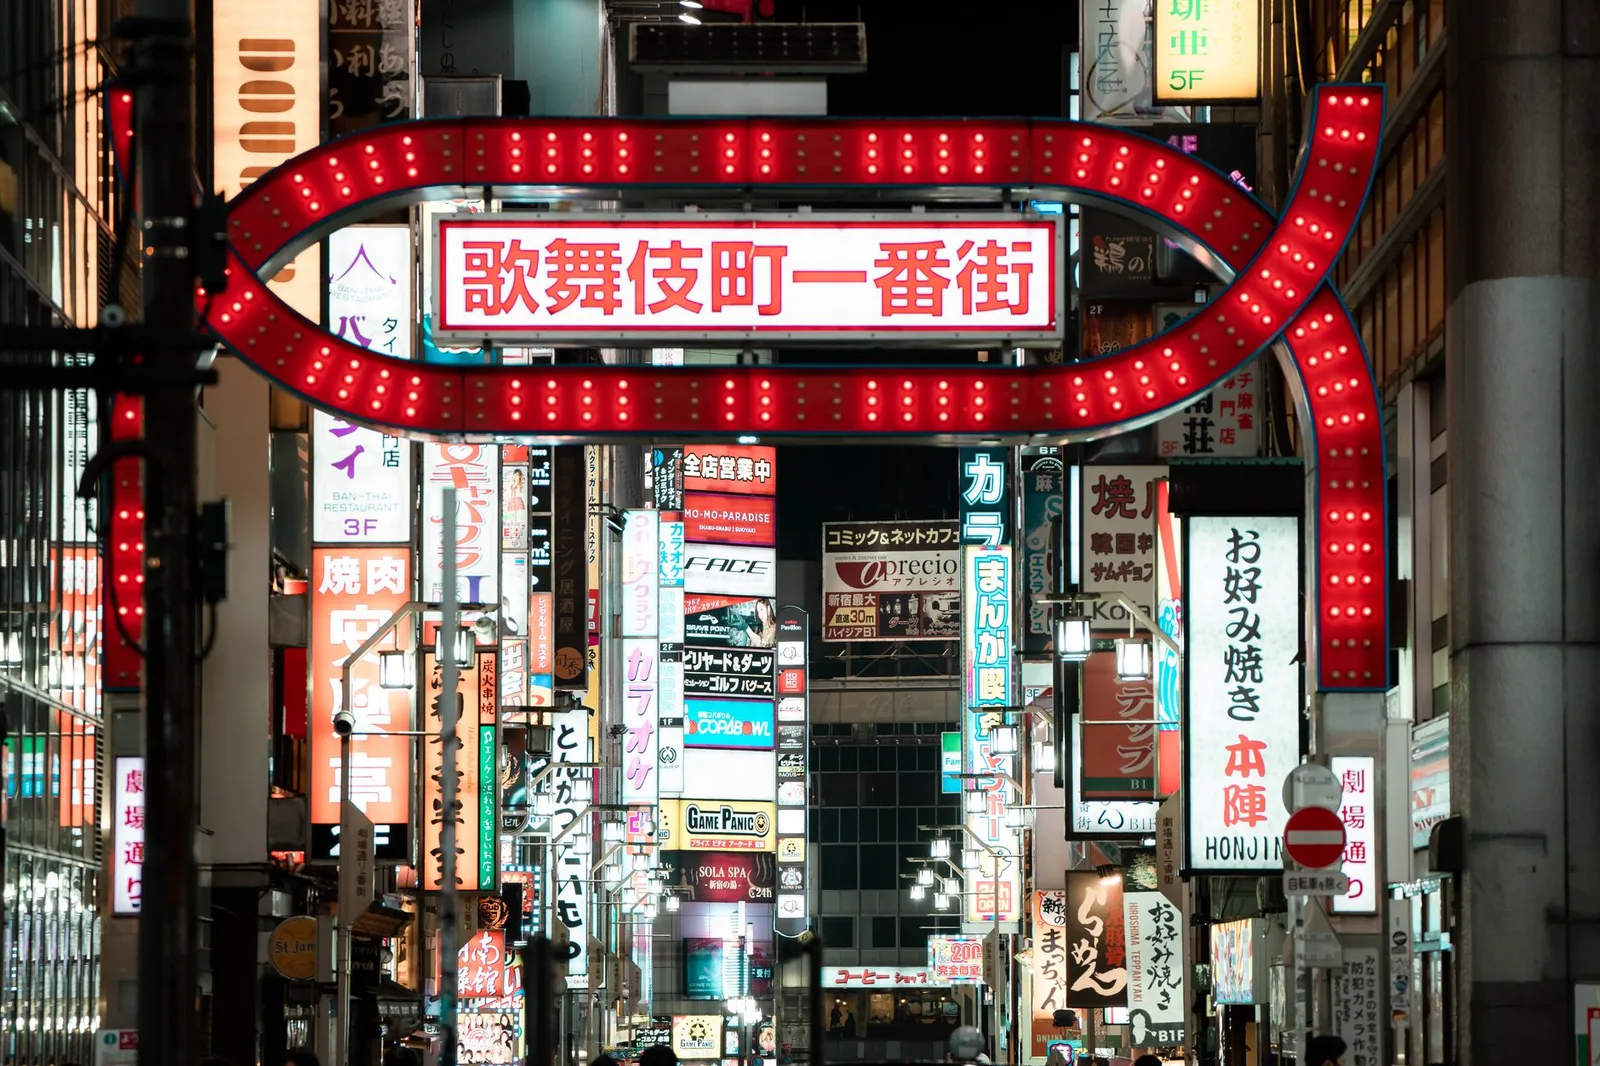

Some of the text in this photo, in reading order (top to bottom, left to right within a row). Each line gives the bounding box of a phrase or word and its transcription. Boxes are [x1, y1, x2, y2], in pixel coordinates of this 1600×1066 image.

[1169, 70, 1204, 91] 5F
[462, 238, 1033, 317] 歌舞伎町一番街
[1089, 305, 1103, 315] 2F
[1039, 446, 1058, 455] 6F
[1162, 441, 1177, 454] 3F
[684, 453, 771, 483] 全店営業中
[333, 492, 392, 500] BAN-THAI
[963, 453, 1004, 546] カラ
[324, 503, 399, 512] RESTAURANT
[684, 508, 770, 523] MO-MO-PARADISE
[344, 518, 378, 536] 3F
[828, 528, 960, 546] コミック&ネットカフェ
[670, 524, 683, 577] カラオケ
[684, 556, 771, 574] FACE
[860, 553, 957, 586] aprecio
[318, 555, 405, 595] 焼肉
[828, 594, 876, 606] 新宿最大
[1092, 601, 1151, 620] Koa
[1223, 528, 1263, 721] お好み焼き
[682, 651, 772, 674] ビリヤード&ダーツ
[481, 660, 495, 715] 炭火串焼
[709, 676, 740, 692] ゴルフ
[741, 679, 772, 693] バグース
[1026, 689, 1039, 698] 3F
[329, 604, 393, 813] 安楽亭
[626, 647, 654, 790] カラオケ
[1131, 779, 1147, 789] B1
[1223, 734, 1268, 828] 本陣
[688, 807, 754, 831] GAME PANIC
[1341, 769, 1367, 899] 劇場通り
[1205, 836, 1284, 861] HONJIN
[699, 866, 747, 879] SOLA SPA
[709, 879, 737, 890] 新宿の湯
[979, 899, 1009, 911] OPEN
[1129, 902, 1140, 946] HIROSHIMA
[1146, 901, 1182, 1011] お好み焼き
[836, 969, 889, 985] コーヒー
[681, 1038, 714, 1048] GAME PANIC
[1158, 1028, 1185, 1042] B1F
